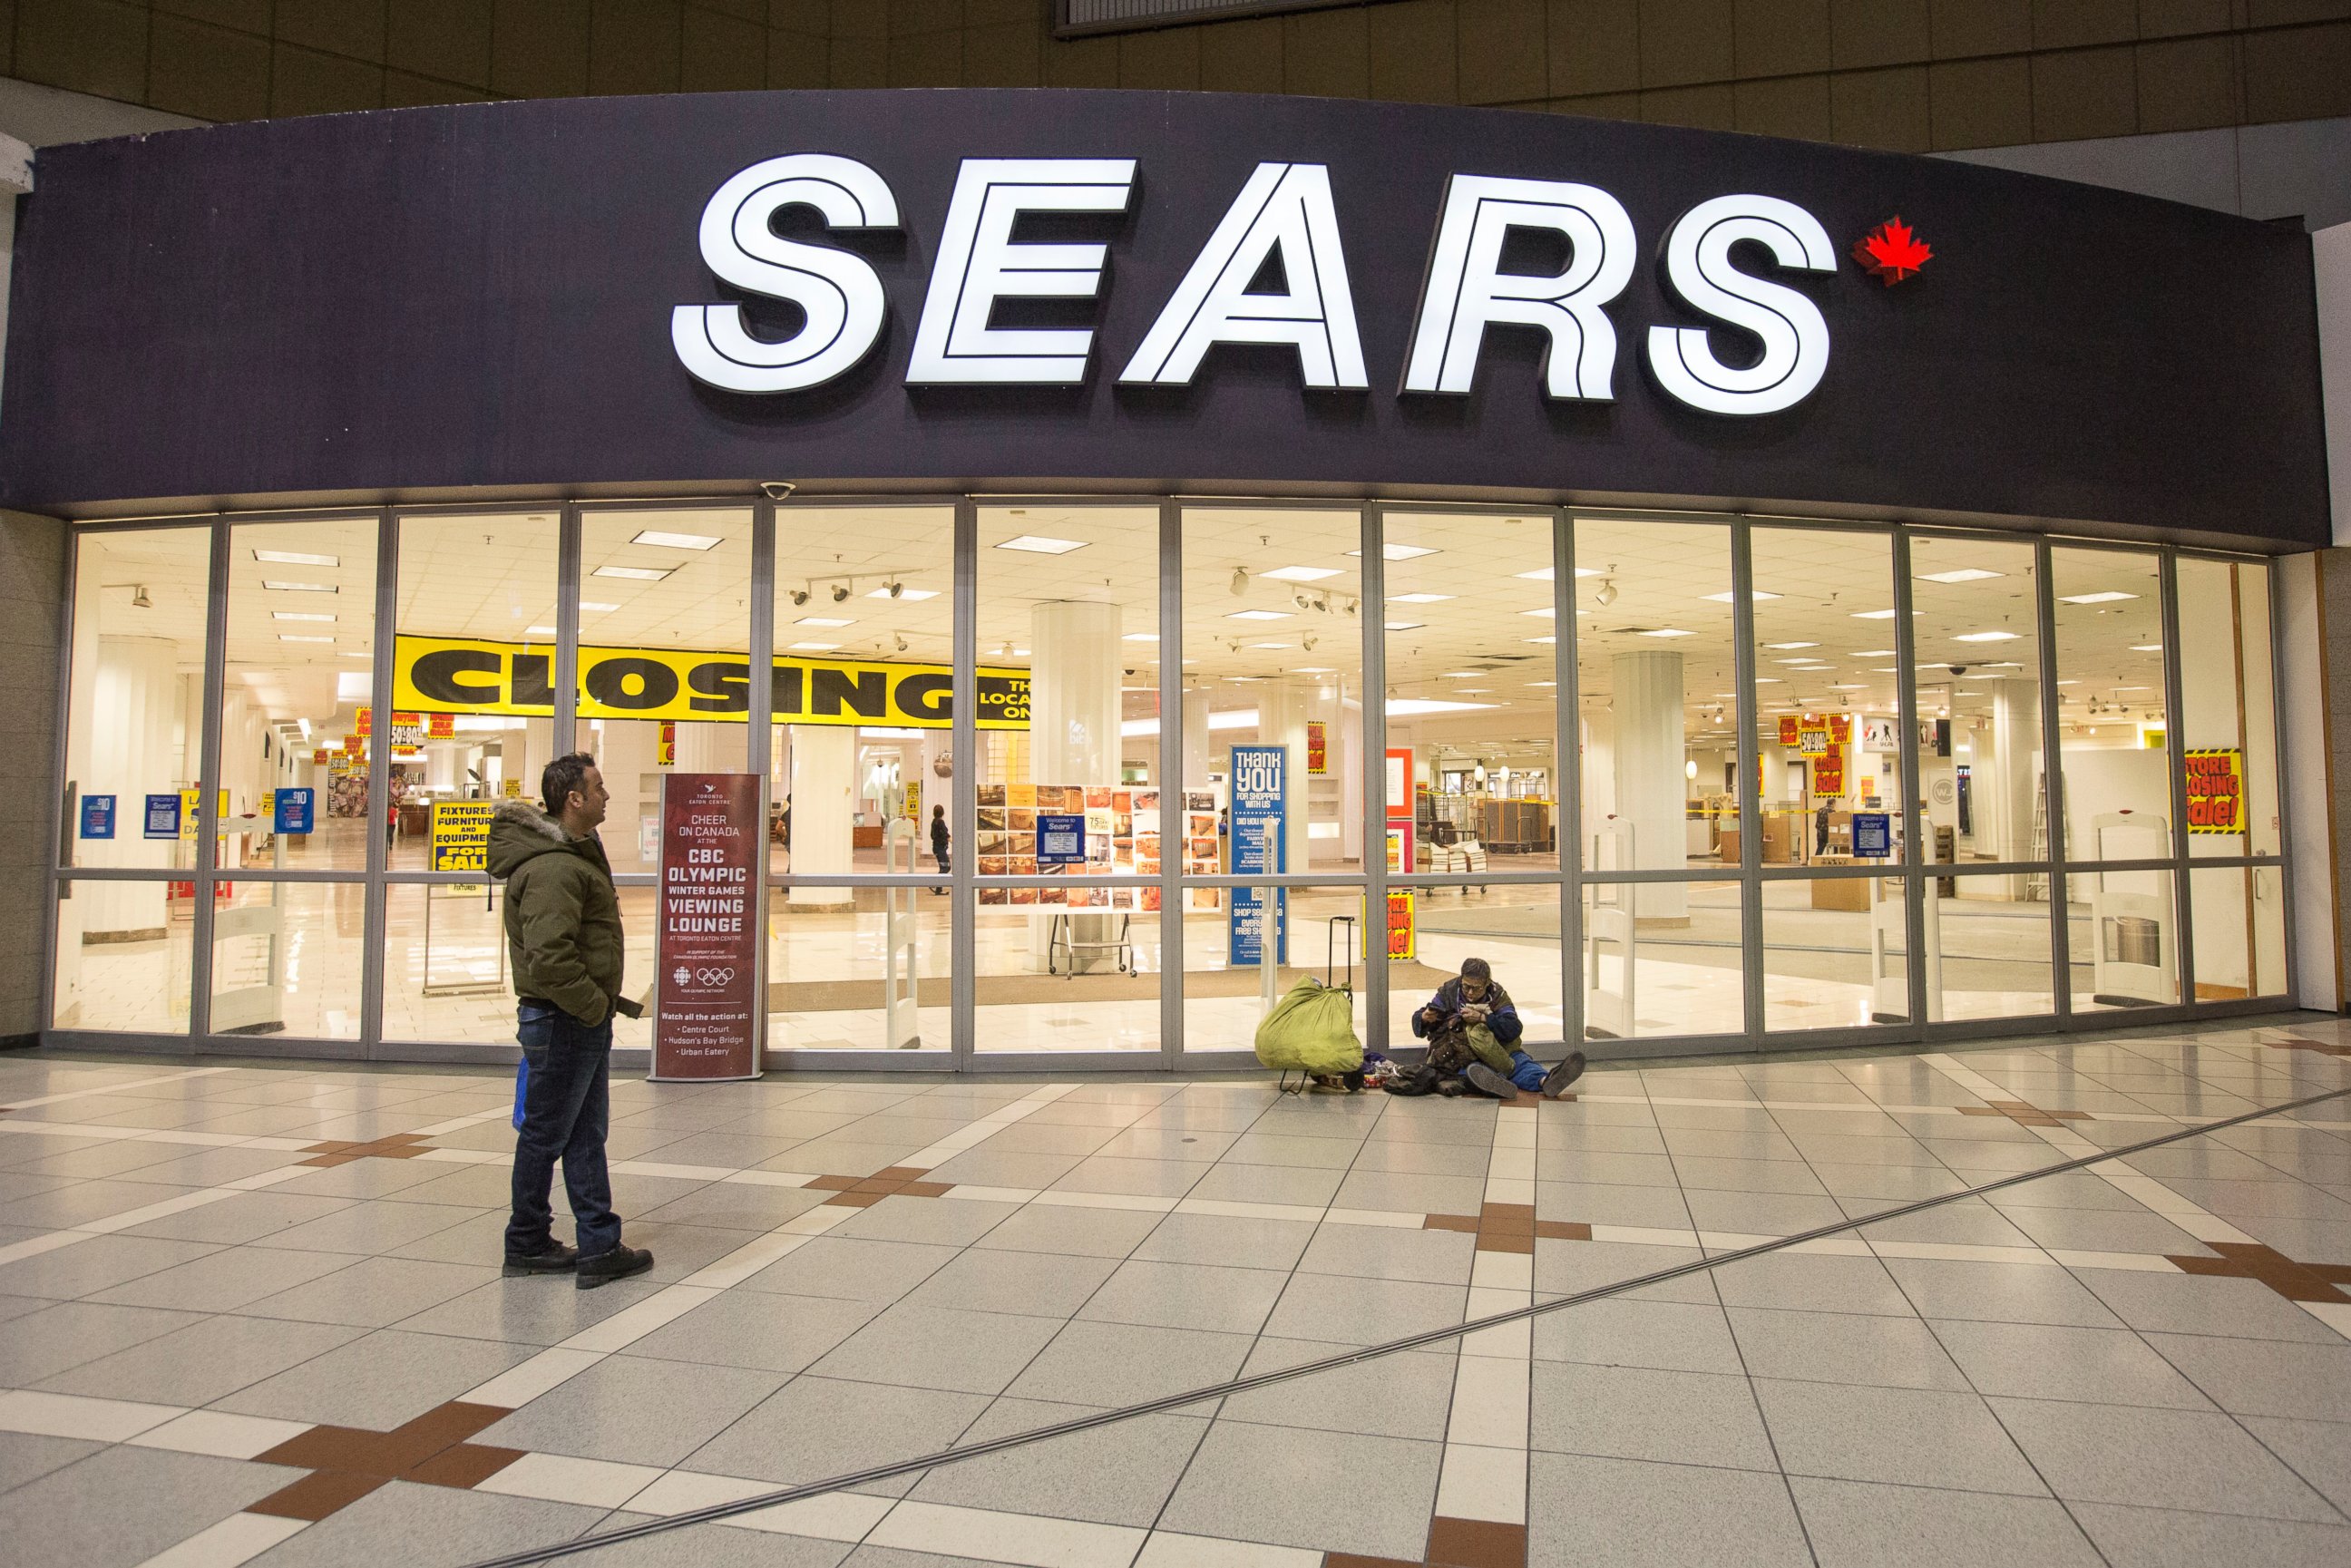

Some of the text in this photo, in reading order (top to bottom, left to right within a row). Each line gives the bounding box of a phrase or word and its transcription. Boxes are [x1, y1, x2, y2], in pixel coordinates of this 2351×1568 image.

[669, 153, 1837, 414] SEARS
[411, 648, 952, 720] CLOSING
[1009, 680, 1030, 692] TH
[980, 692, 1030, 706] LOCA
[1003, 706, 1030, 719] ON
[1308, 751, 1324, 769] ale!
[1815, 773, 1843, 794] Sale!
[2187, 774, 2239, 796] OSING
[293, 791, 307, 804] $10
[691, 815, 727, 825] CHEER
[436, 834, 488, 843] EQUIPME
[679, 827, 740, 836] ON CANADA
[688, 849, 725, 863] CBC
[668, 867, 746, 882] OLYMPIC
[668, 886, 745, 895] WINTER GAMES
[668, 899, 744, 914] VIEWING
[1234, 909, 1251, 917] SHOP
[669, 918, 742, 932] LOUNGE
[1388, 930, 1411, 954] le!
[661, 1012, 683, 1020] Watch
[684, 1012, 697, 1020] all
[697, 1012, 708, 1020] the
[711, 1012, 736, 1020] action
[719, 1037, 744, 1045] Bridge
